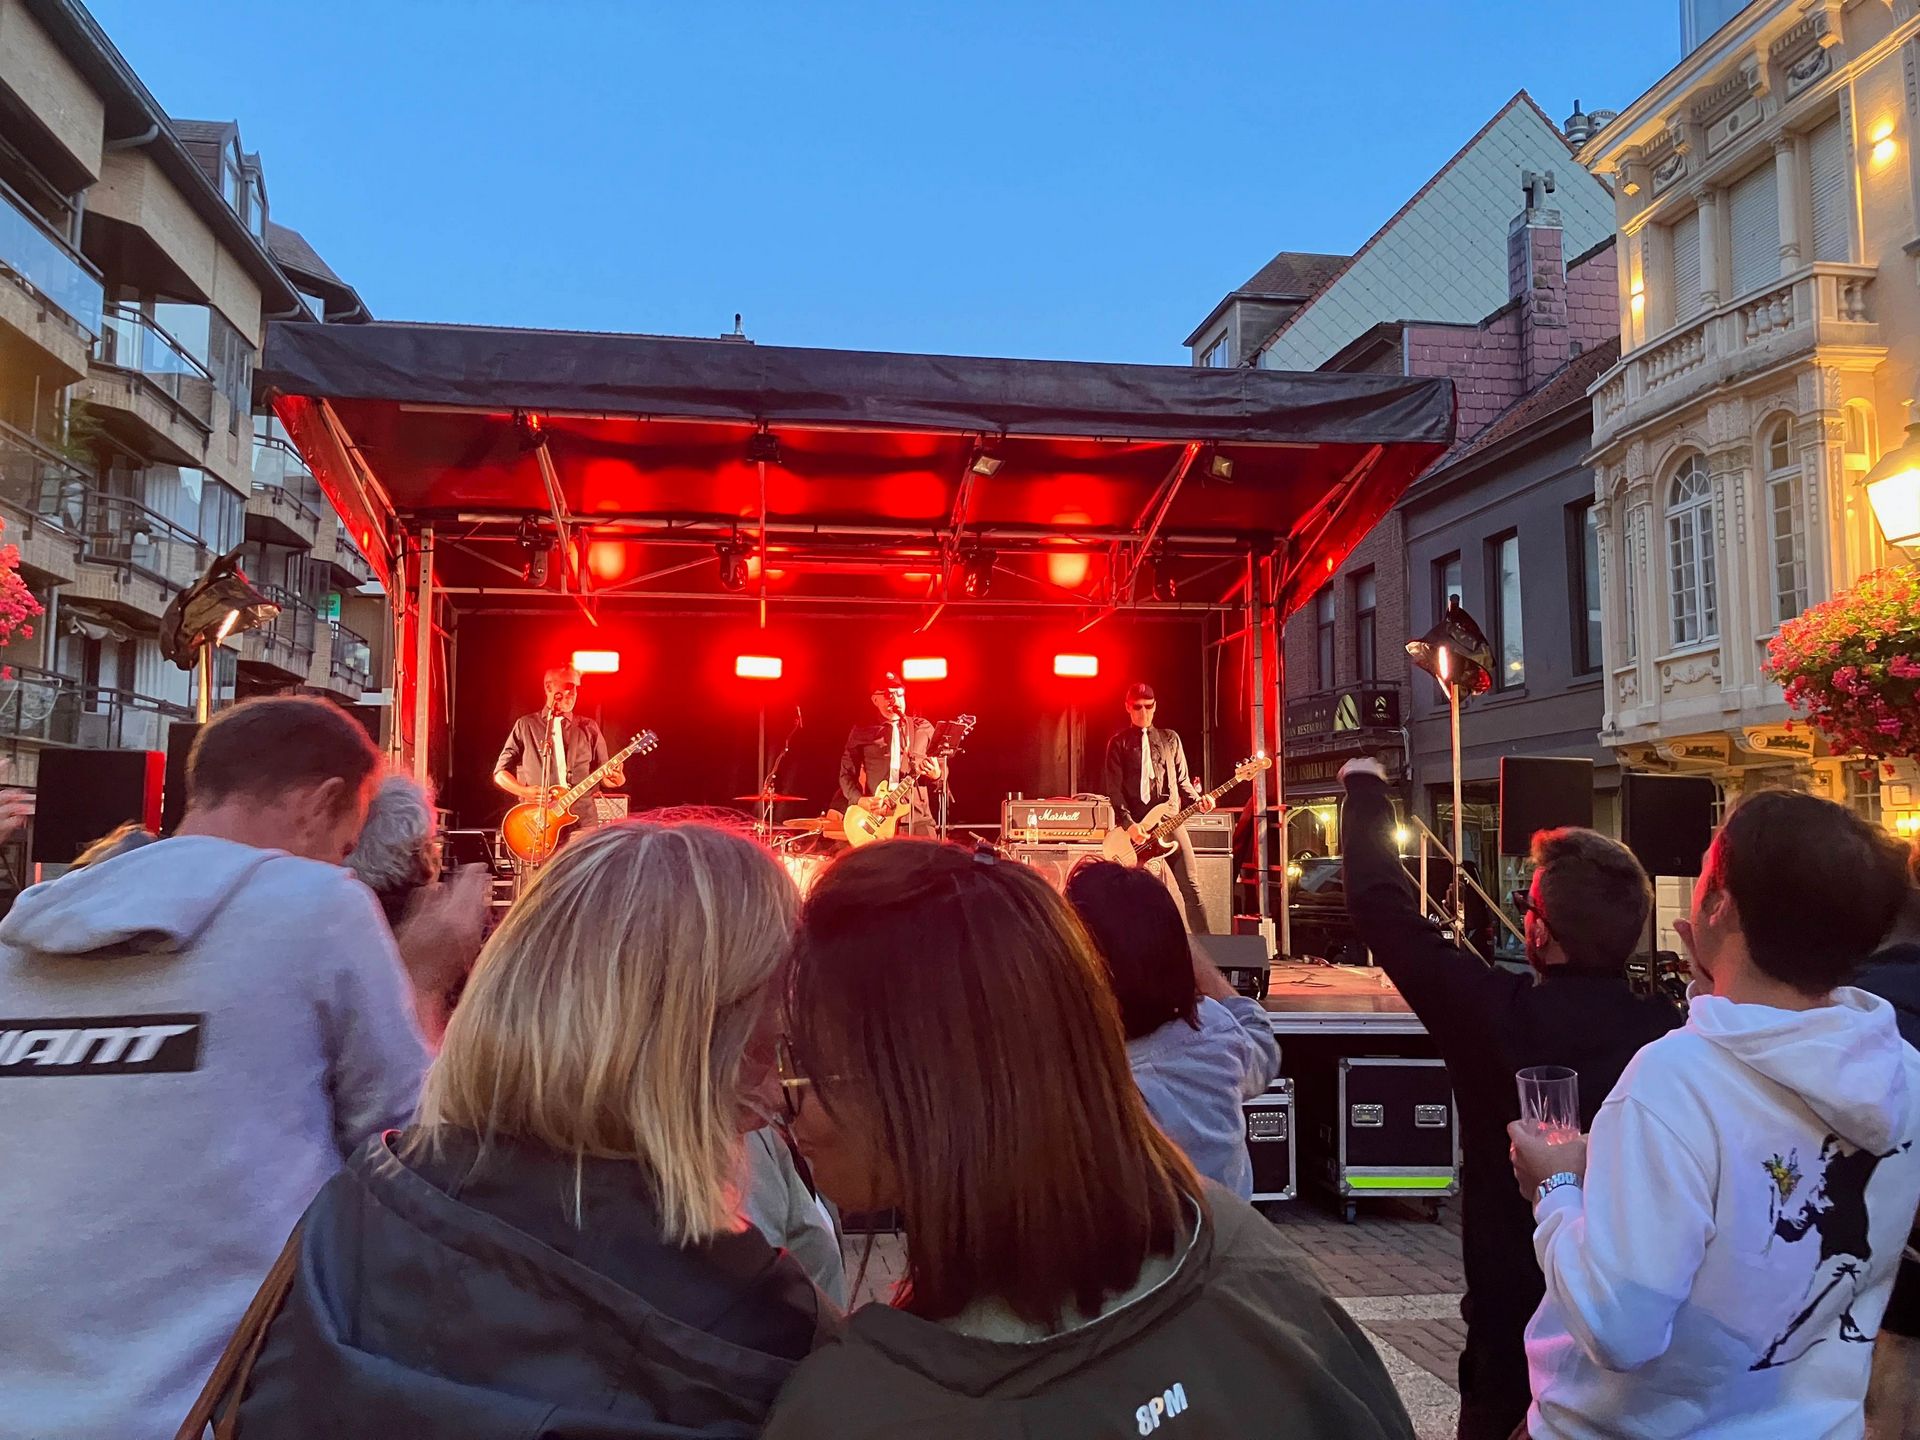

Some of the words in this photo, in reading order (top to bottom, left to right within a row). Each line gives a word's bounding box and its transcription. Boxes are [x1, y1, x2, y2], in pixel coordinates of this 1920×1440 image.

[1299, 761, 1324, 780] INDIAN
[1038, 808, 1080, 821] Marshall
[0, 1023, 199, 1066] IANT
[1135, 1382, 1189, 1436] 8PM
